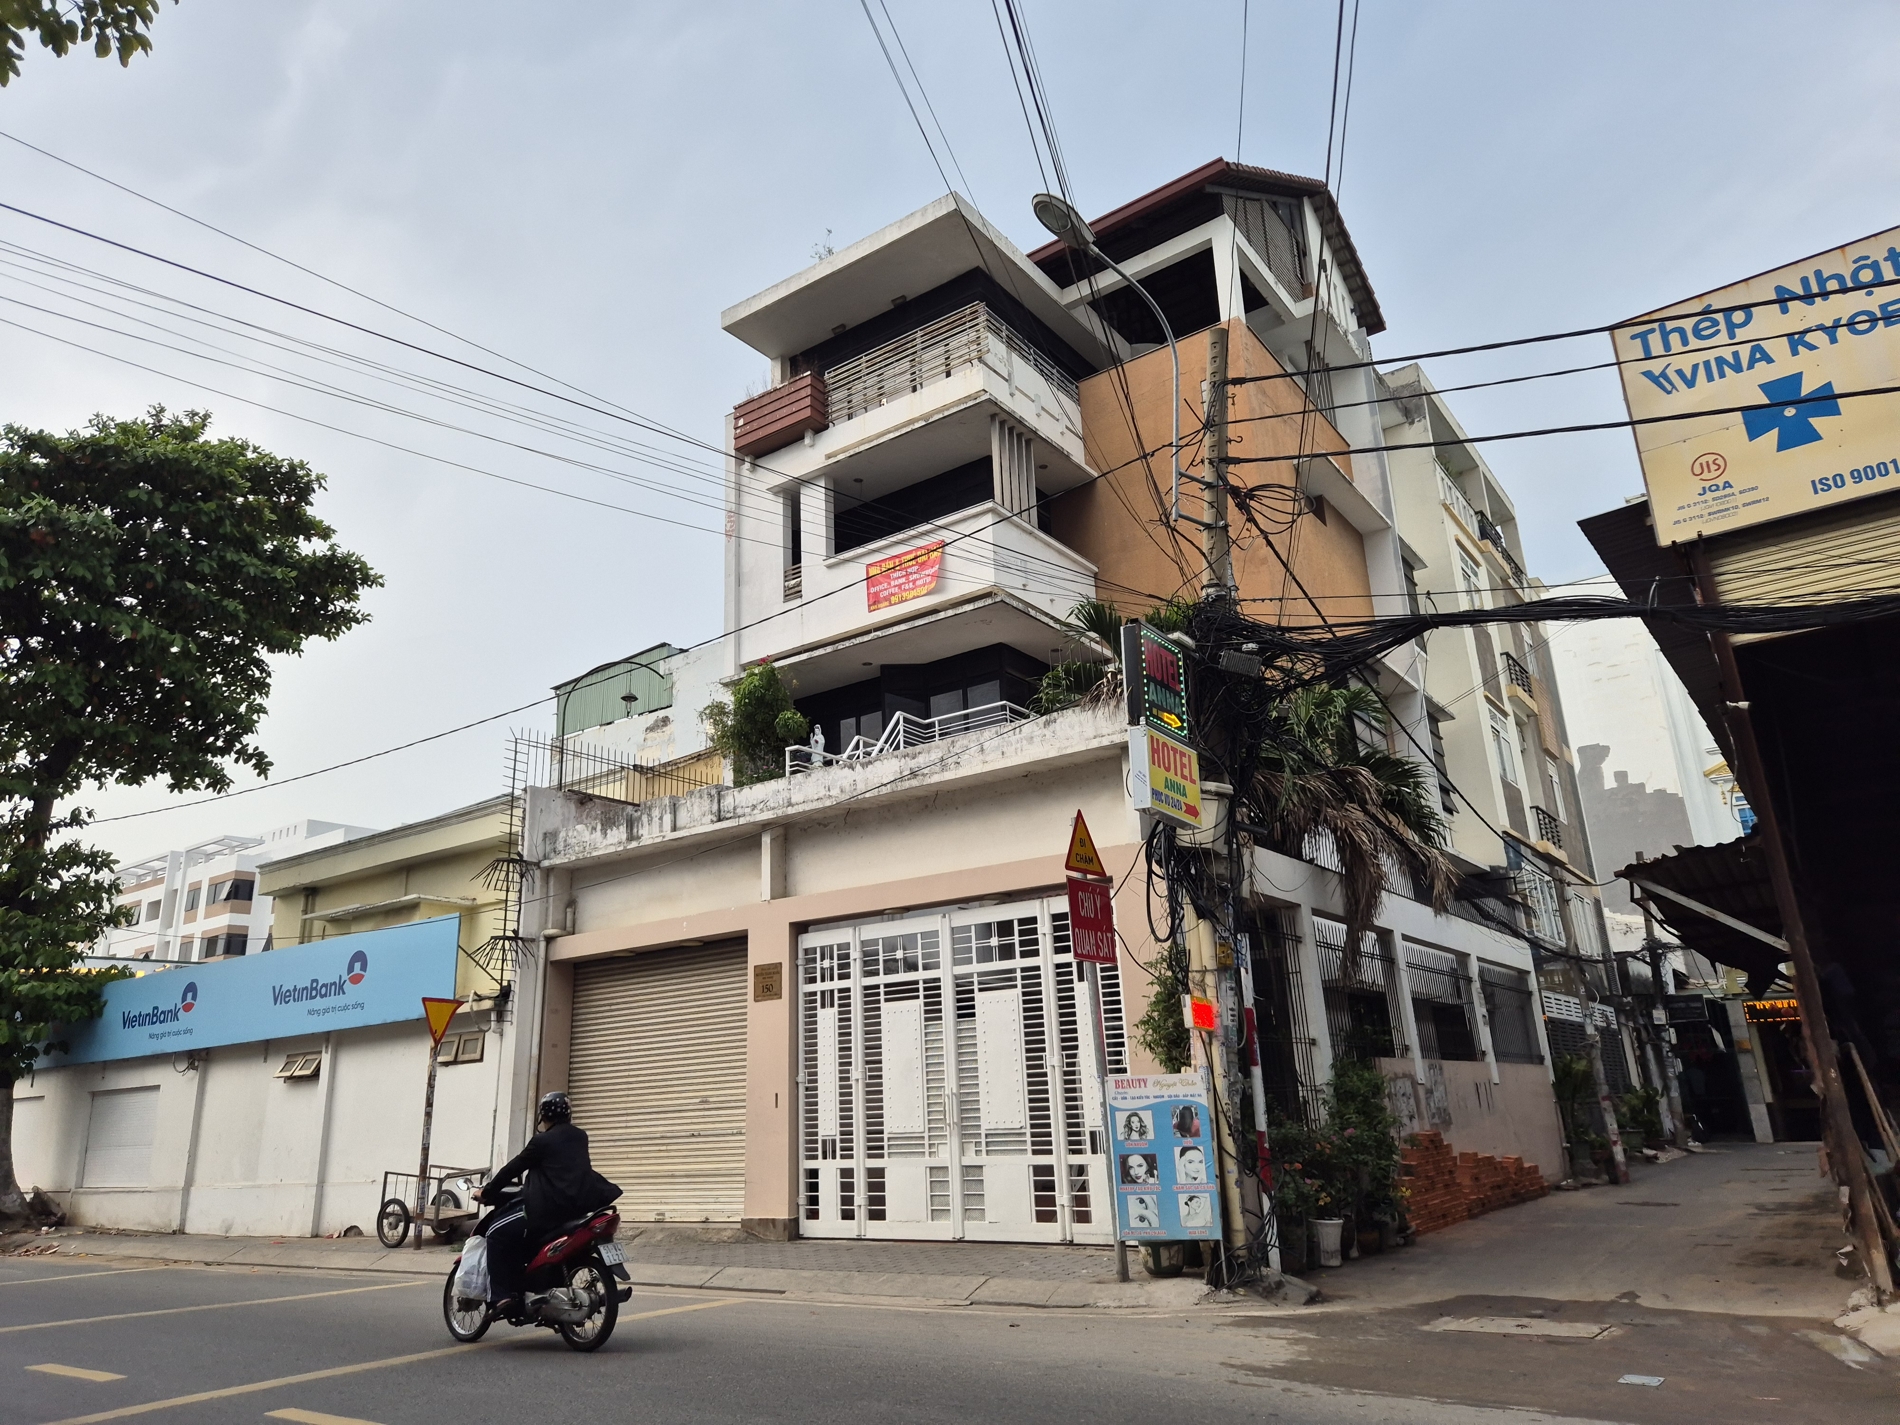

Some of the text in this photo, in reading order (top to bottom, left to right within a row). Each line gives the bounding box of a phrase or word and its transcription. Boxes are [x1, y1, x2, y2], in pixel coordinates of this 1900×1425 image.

[1630, 246, 1900, 358] Thép Nhật
[1674, 343, 1776, 389] VINA
[1692, 457, 1722, 477] JIS
[1810, 458, 1900, 495] ISO 9001
[1697, 480, 1734, 496] JQA
[1144, 639, 1182, 692] HOTEL
[1149, 682, 1182, 716] ANNA
[1150, 735, 1196, 785] HOTEL
[1164, 776, 1187, 798] ANNA
[1079, 838, 1086, 848] ĐI
[1078, 887, 1101, 919] CHÚ Ý
[1075, 925, 1113, 958] QUAN SÁT
[272, 974, 348, 1006] VietinBank
[762, 984, 773, 993] 150
[122, 1003, 181, 1030] VietinBank
[1114, 1078, 1148, 1089] BEAUTY
